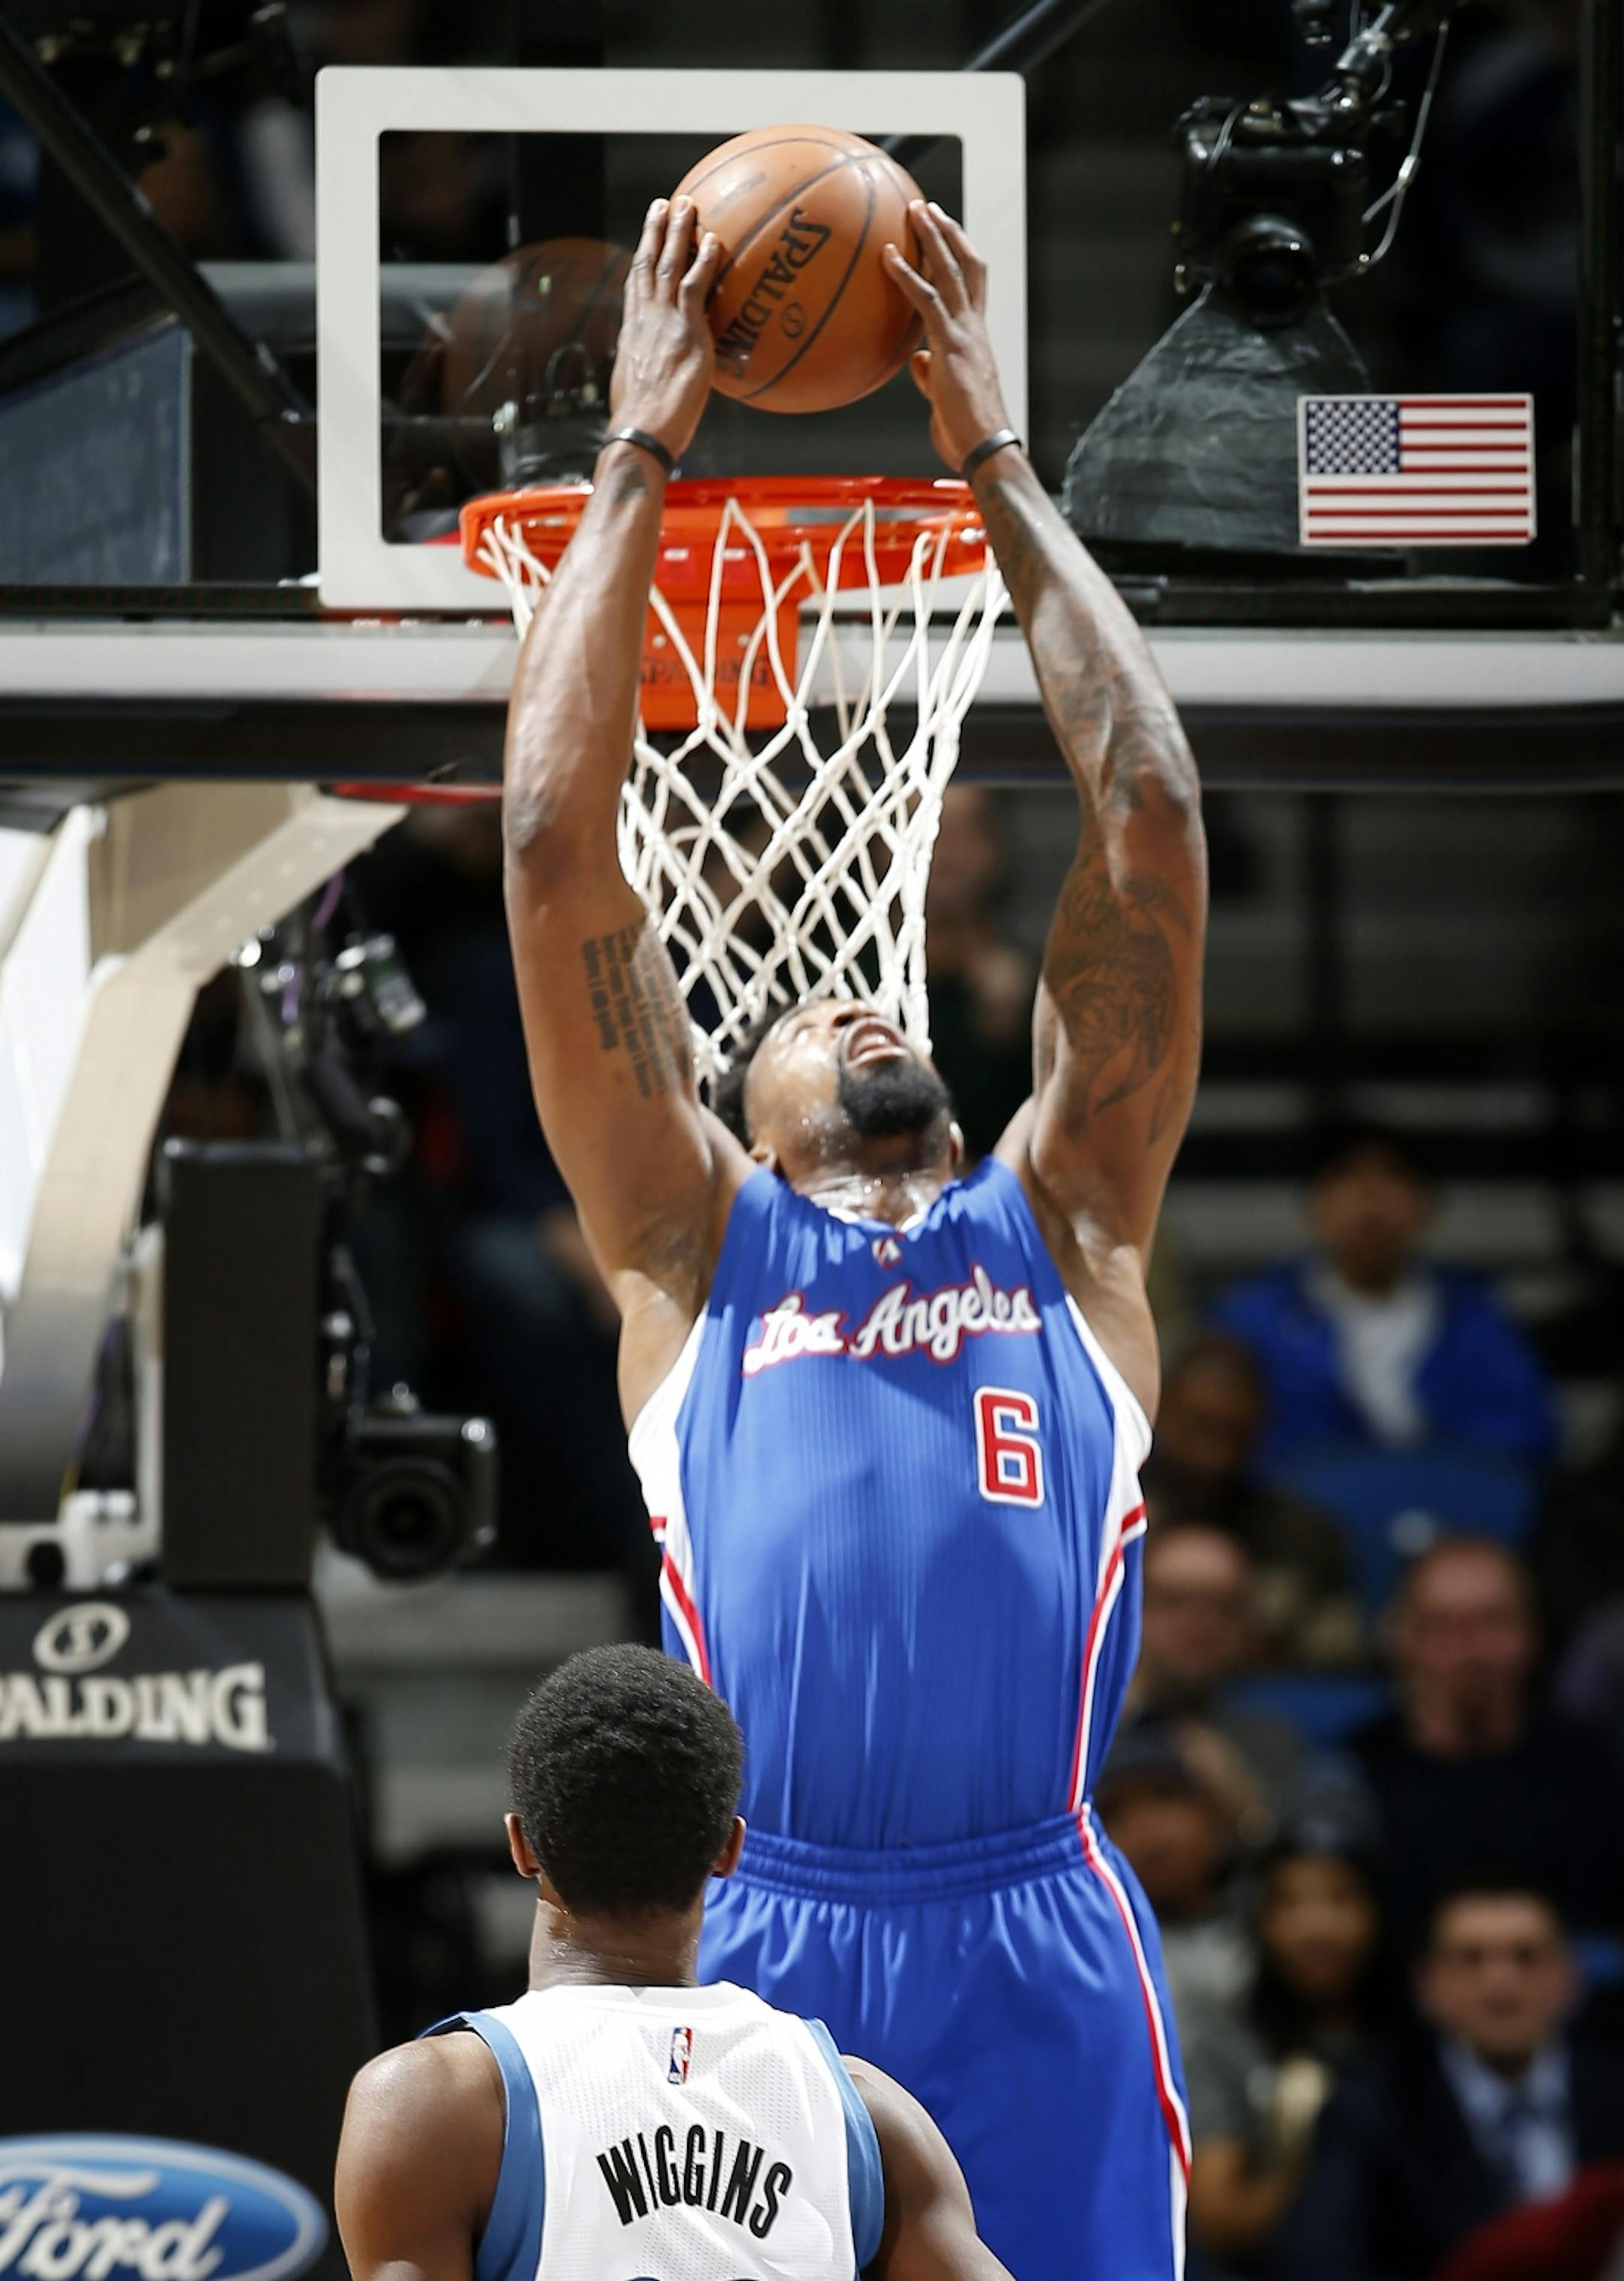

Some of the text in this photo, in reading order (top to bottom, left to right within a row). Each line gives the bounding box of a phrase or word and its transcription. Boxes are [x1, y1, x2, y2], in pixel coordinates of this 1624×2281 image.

[742, 1263, 1043, 1378] Los Angeles
[974, 1385, 1046, 1509] 6
[0, 1661, 274, 1754] ALDING
[0, 2163, 231, 2281] Ford
[595, 2124, 794, 2240] WIGGINS
